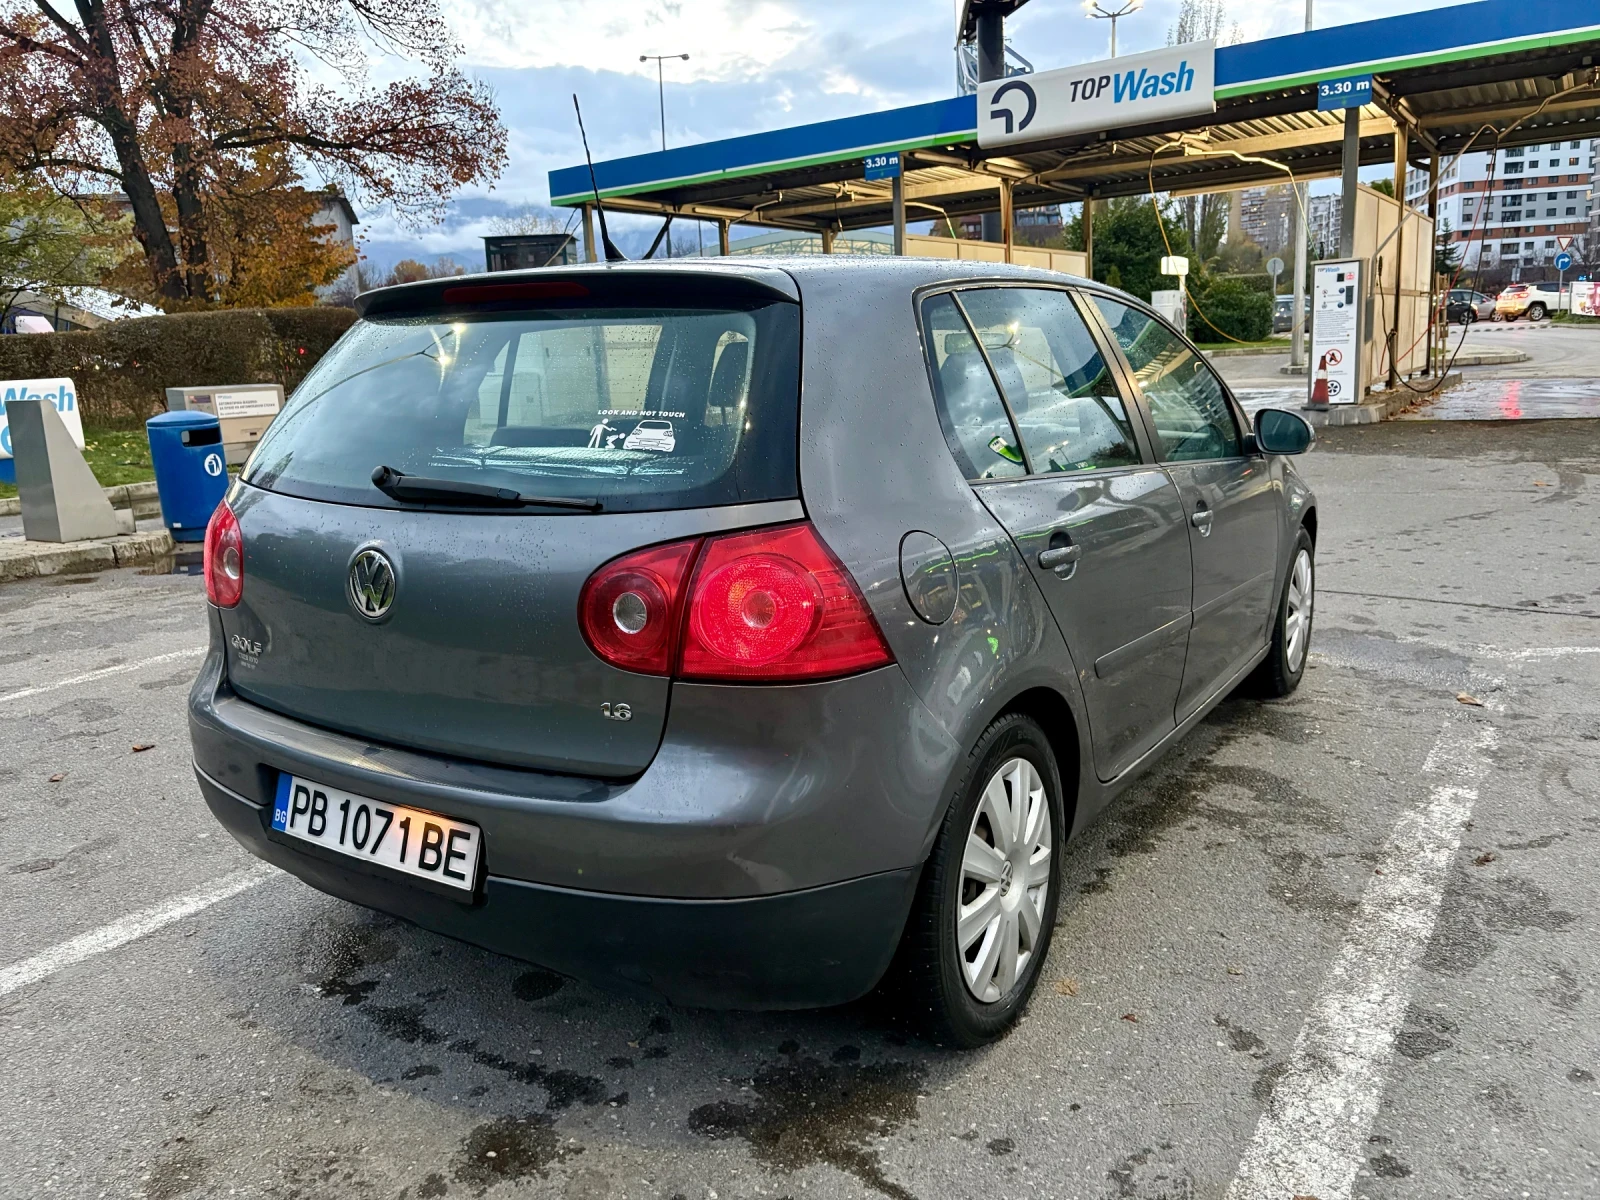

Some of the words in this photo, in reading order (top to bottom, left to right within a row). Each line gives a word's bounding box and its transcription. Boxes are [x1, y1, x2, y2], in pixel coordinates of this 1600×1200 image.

[1320, 81, 1352, 96] 3.30
[1356, 80, 1370, 91] m
[866, 156, 887, 168] 3.30
[889, 156, 899, 165] m
[231, 634, 262, 657] GOLF
[274, 808, 287, 824] BG
